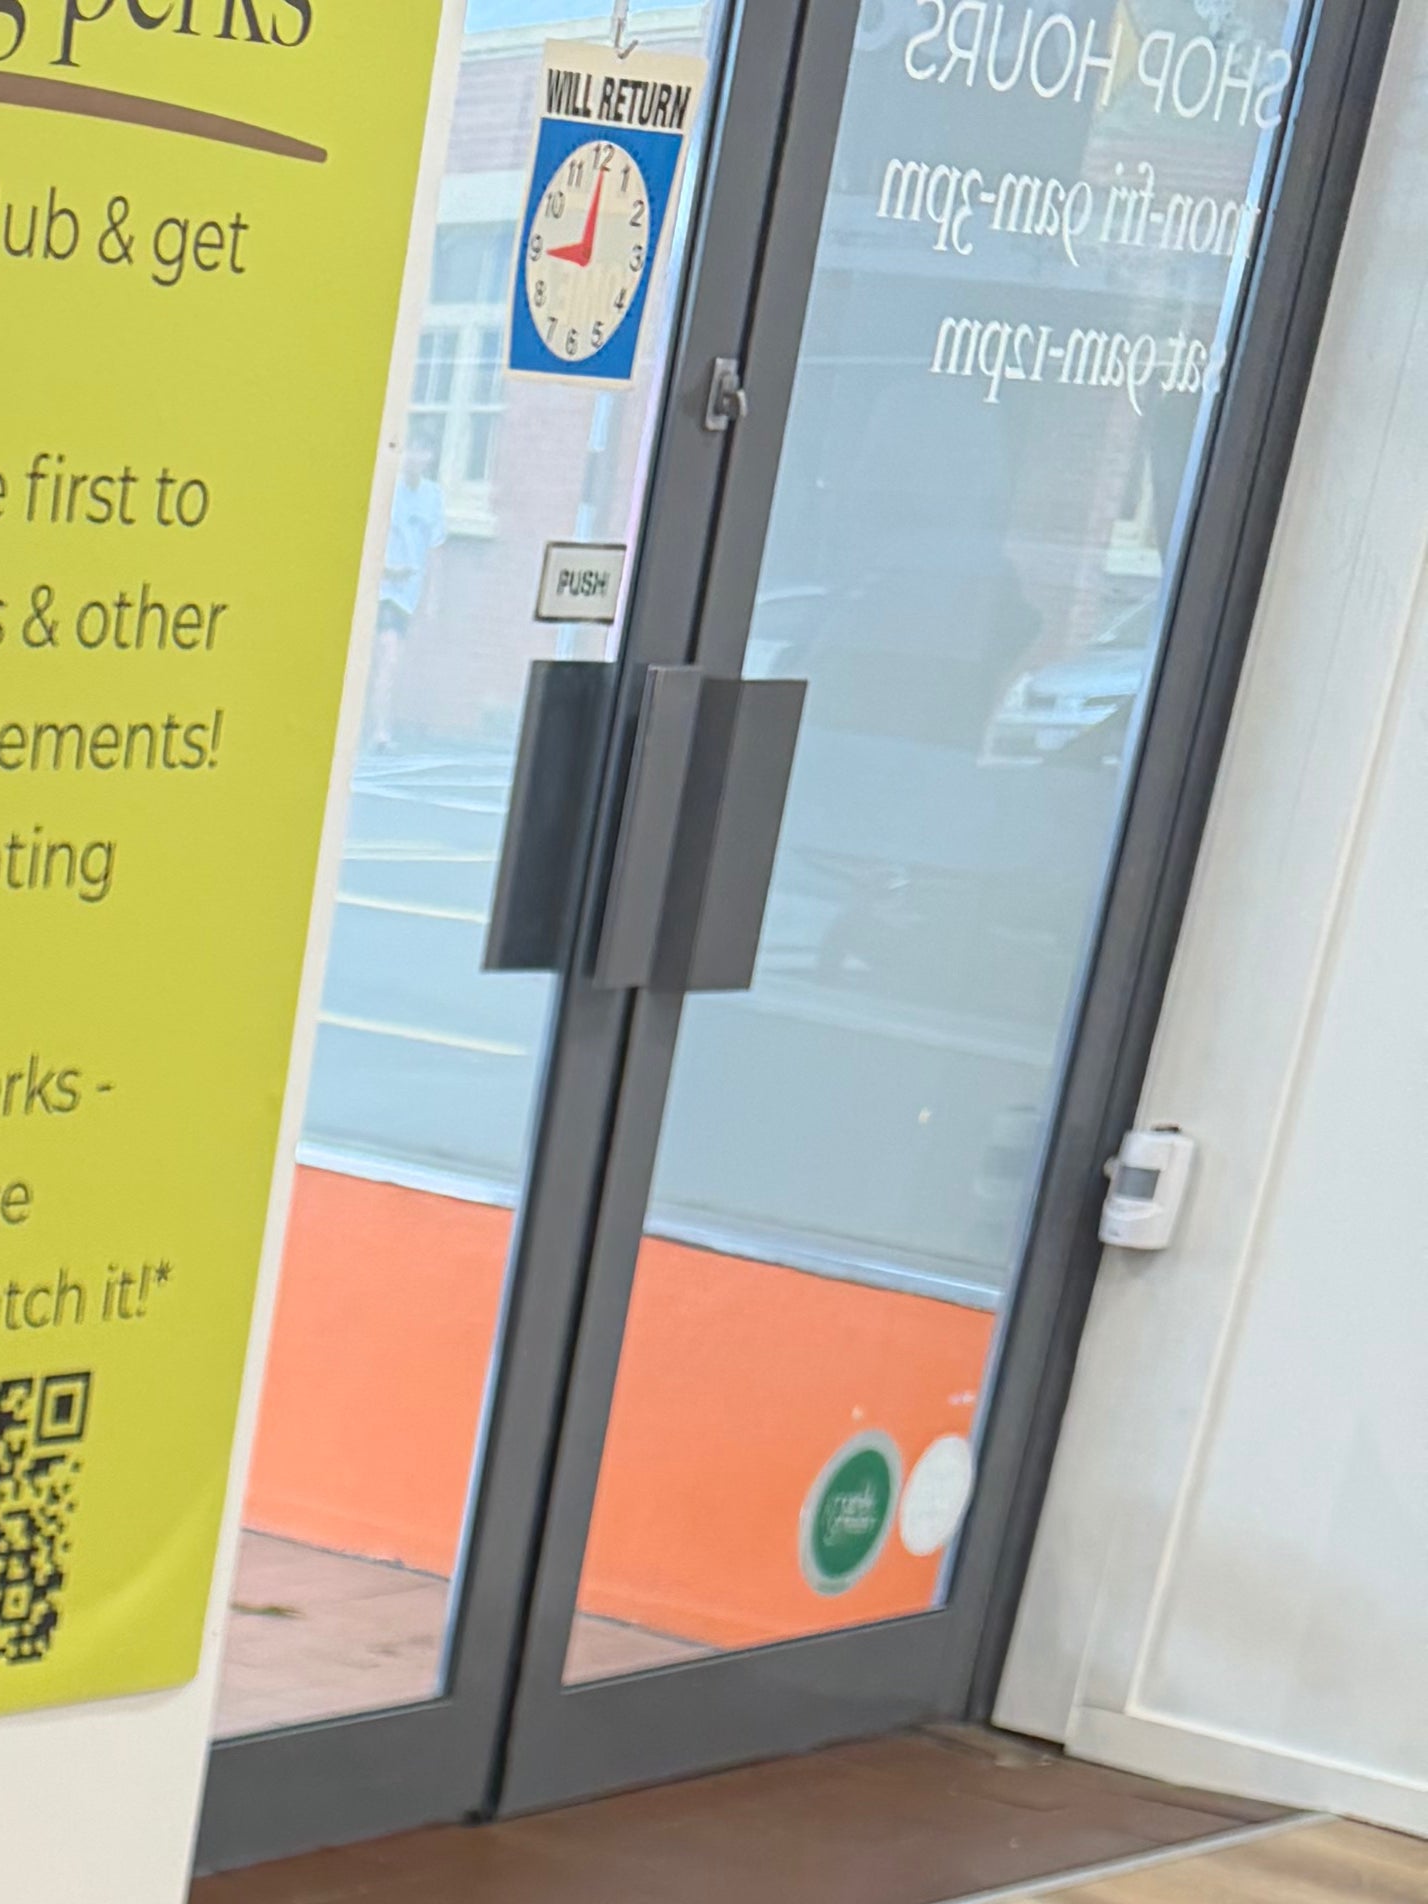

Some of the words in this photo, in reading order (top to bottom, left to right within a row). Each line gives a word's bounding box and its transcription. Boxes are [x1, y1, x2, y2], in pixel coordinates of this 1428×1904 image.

[547, 68, 592, 117] WILL
[597, 76, 692, 130] RETURN
[593, 143, 615, 171] 12
[568, 159, 584, 187] 11
[621, 164, 631, 192] 1
[545, 190, 566, 219] 10
[629, 200, 644, 227] 2
[98, 196, 135, 265] &
[151, 212, 249, 287] get
[530, 234, 543, 262] 9
[629, 245, 643, 272] 3
[533, 280, 547, 308] 8
[614, 288, 627, 313] 4
[547, 317, 558, 342] 7
[565, 328, 578, 356] 6
[591, 321, 604, 348] 5
[25, 453, 139, 525] first
[155, 468, 209, 528] to
[556, 568, 610, 597] PUSH
[22, 584, 59, 648] &
[76, 583, 228, 650] other
